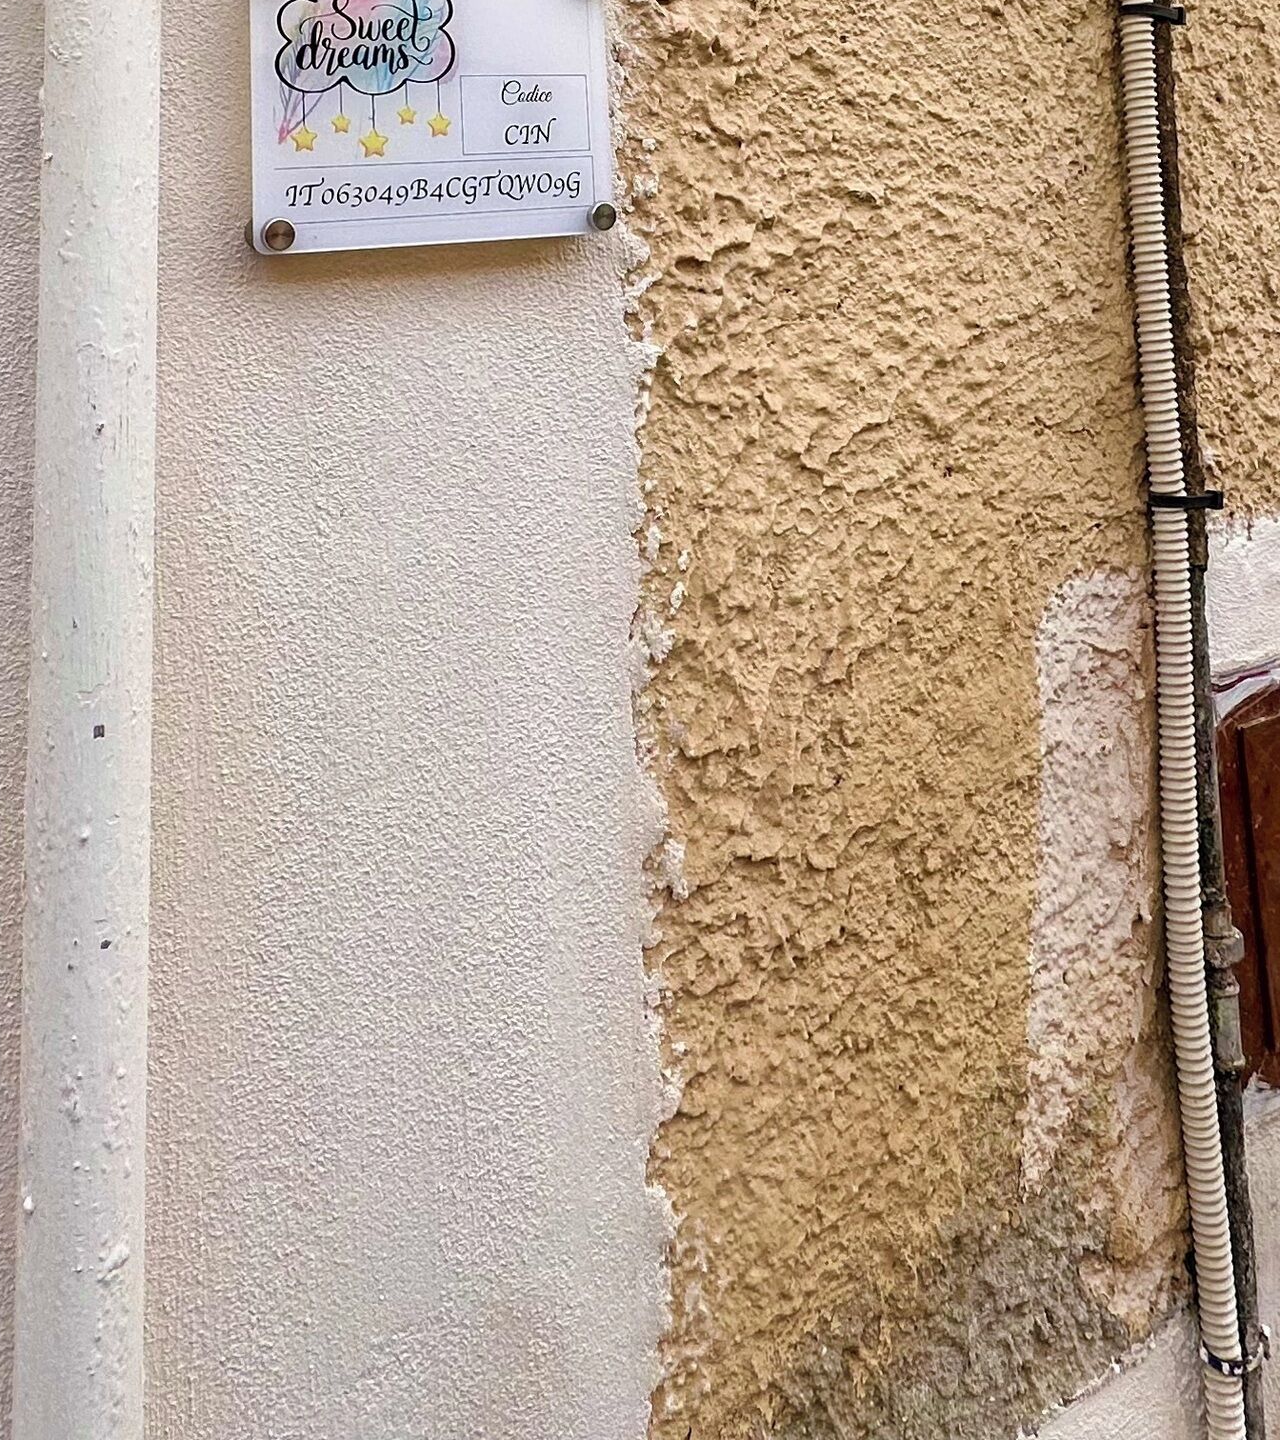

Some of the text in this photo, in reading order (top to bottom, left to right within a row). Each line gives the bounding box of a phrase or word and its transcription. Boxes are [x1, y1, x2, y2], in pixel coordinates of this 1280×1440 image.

[296, 20, 433, 76] dreams
[501, 79, 553, 106] Codice
[504, 118, 557, 146] CIN
